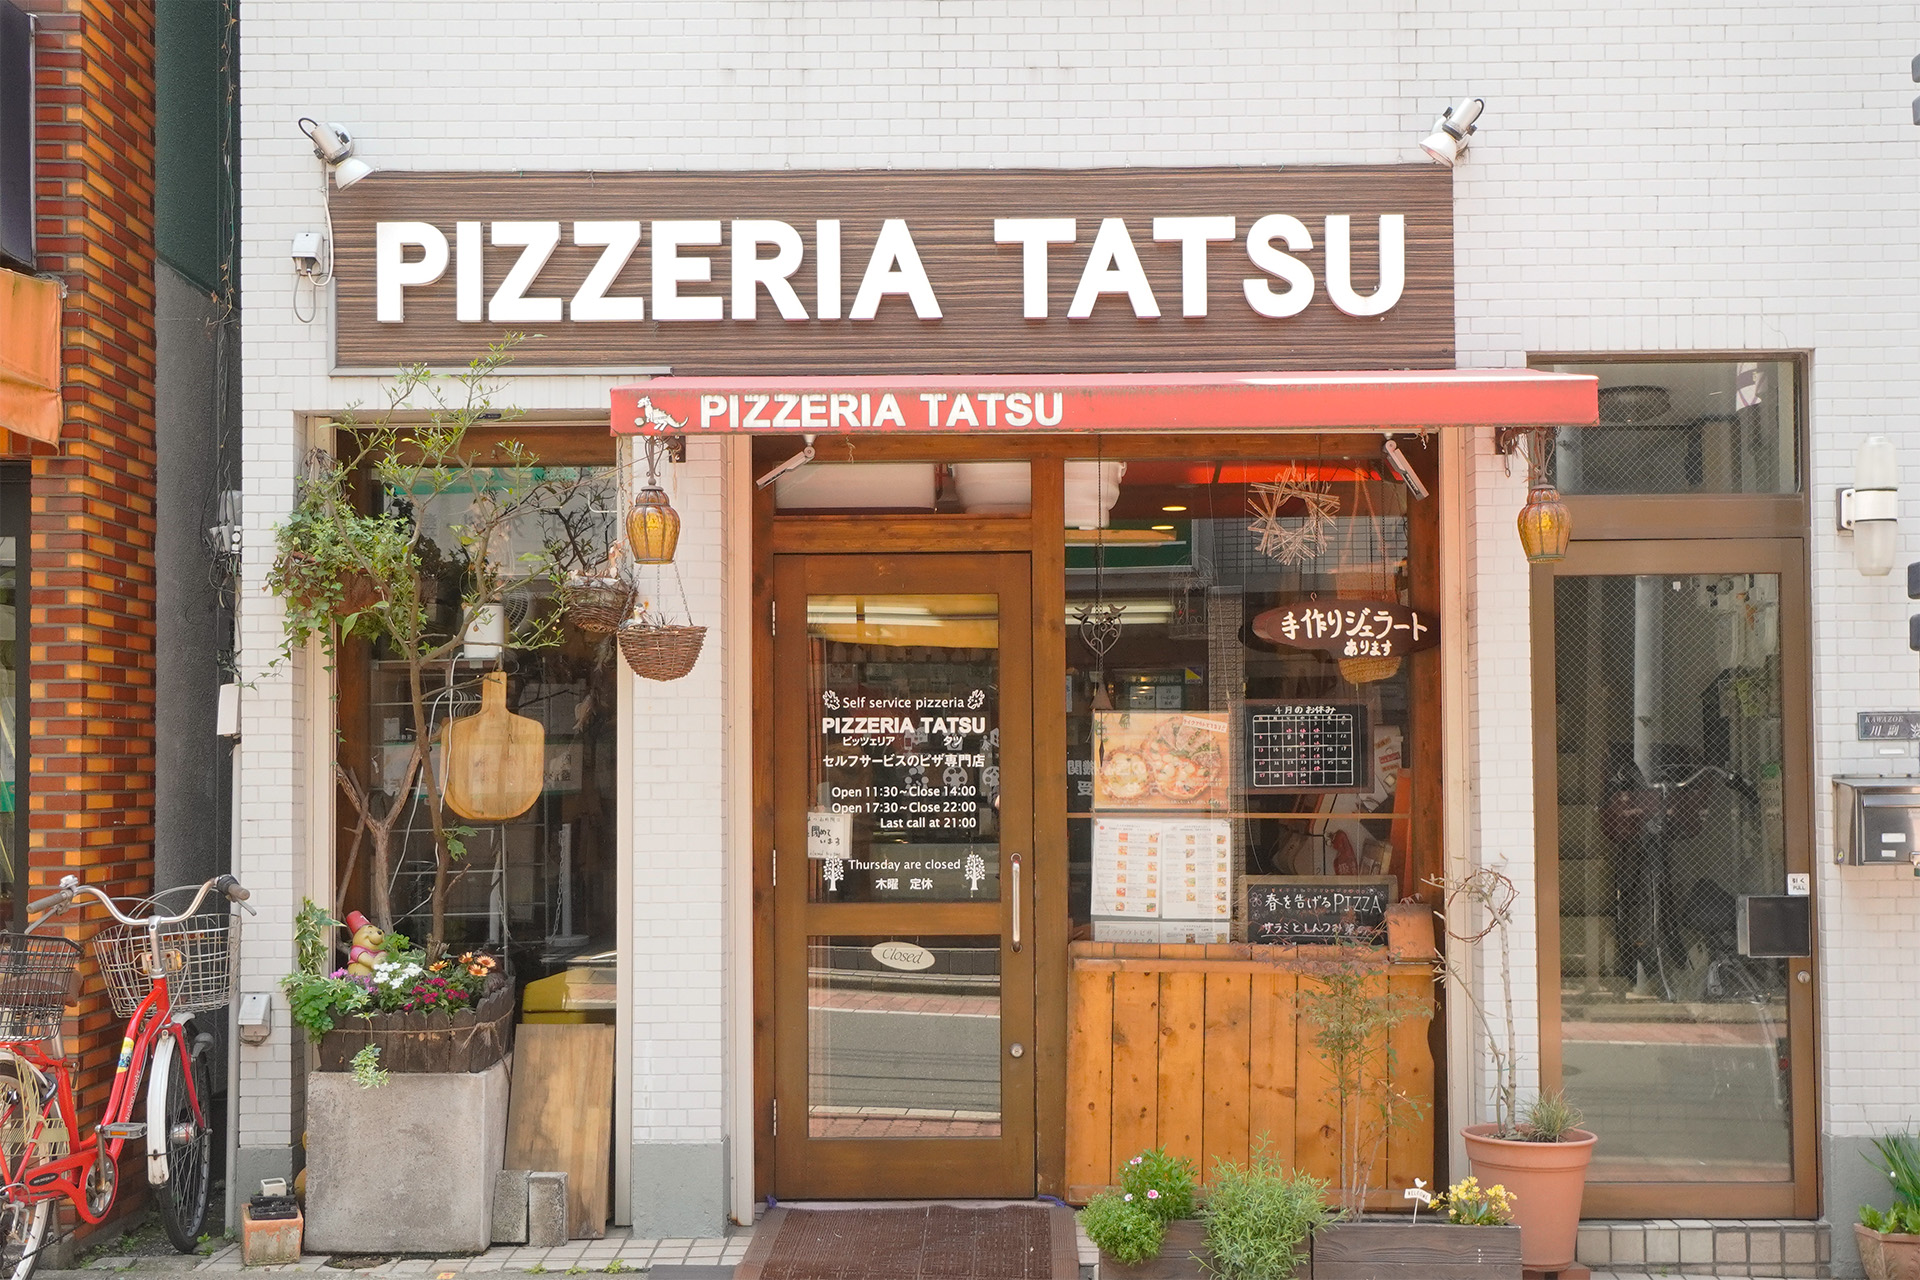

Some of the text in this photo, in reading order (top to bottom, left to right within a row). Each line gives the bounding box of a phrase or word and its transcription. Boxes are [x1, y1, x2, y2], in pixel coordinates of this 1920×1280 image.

[375, 213, 1406, 324] PIZZERIA TATSU
[699, 391, 1064, 430] PIZZERIA TATSU
[1281, 607, 1428, 641] 手作りジェラート
[1343, 639, 1392, 656] あります
[842, 697, 965, 710] Self service pizzeria
[822, 717, 986, 734] PIZZERIA TATSU
[842, 736, 963, 746] ピッツェリア タツ
[822, 754, 985, 768] セルフサービスのピザ専門店
[832, 787, 862, 799] Open
[944, 786, 976, 797] 14:00
[832, 802, 862, 814] Open
[943, 802, 976, 813] 22:00
[880, 817, 976, 828] Last call at 21:00
[848, 858, 961, 870] Thursday are closed
[875, 878, 933, 890] 木曜 定休
[882, 947, 923, 964] Closed
[1408, 1190, 1429, 1200] WELCOME
